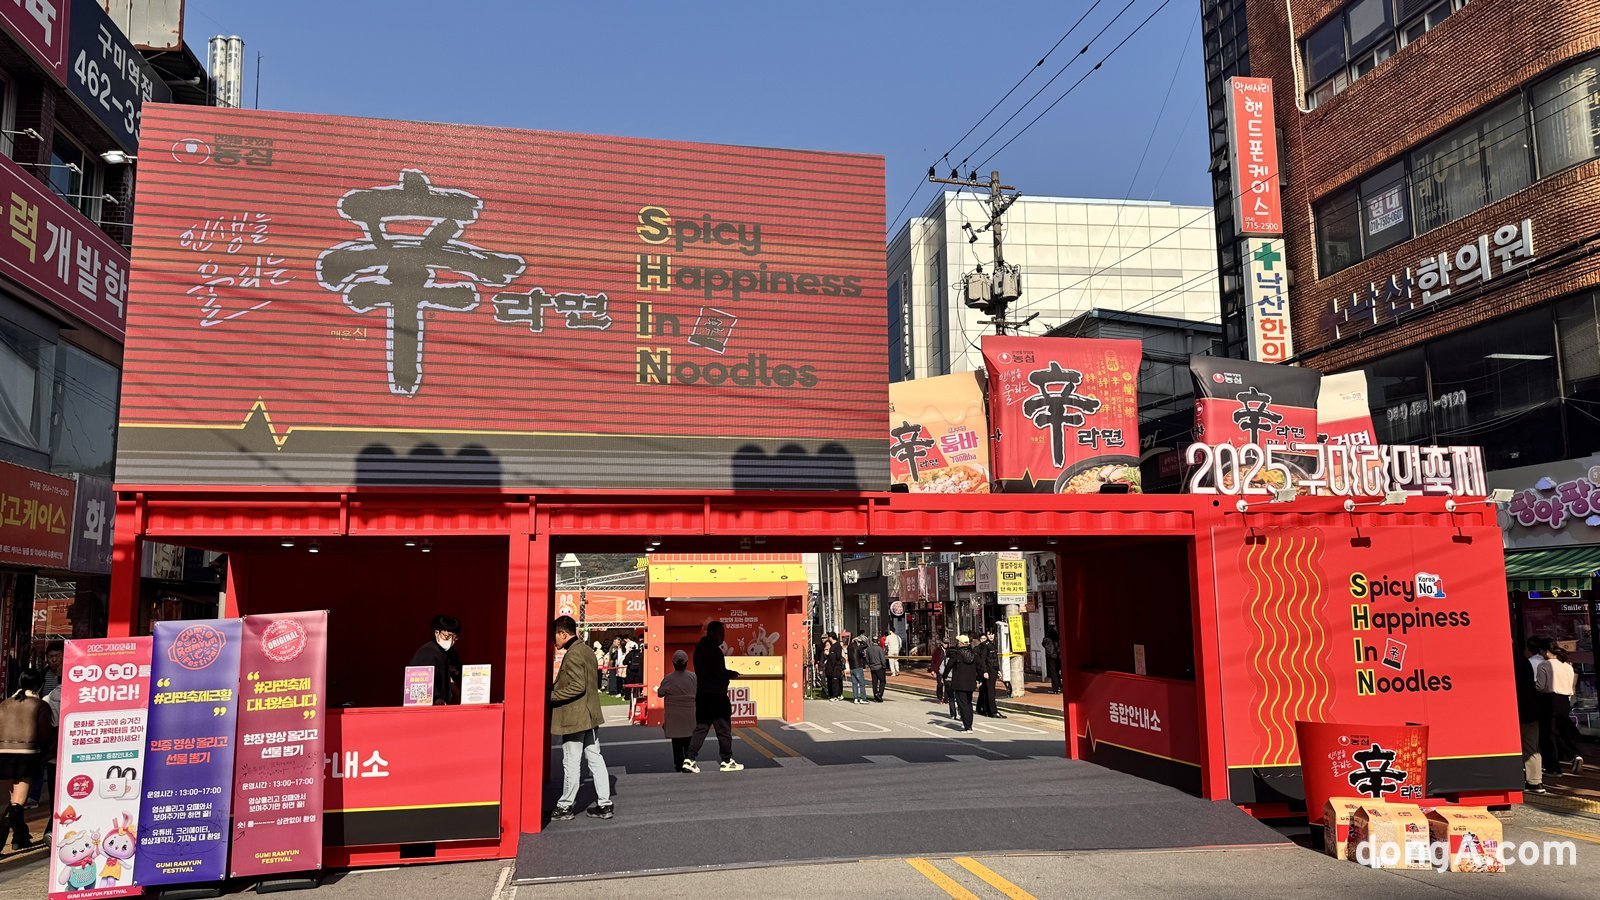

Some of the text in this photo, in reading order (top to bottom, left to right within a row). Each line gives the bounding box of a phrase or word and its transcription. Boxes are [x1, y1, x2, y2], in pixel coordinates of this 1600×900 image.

[1234, 81, 1270, 93] 악세사리
[213, 145, 272, 166] 농심
[1244, 96, 1270, 215] 핸드폰케이스
[1369, 186, 1401, 219] 임대
[180, 212, 272, 254] 인생을
[637, 206, 762, 257] Spicy
[1245, 222, 1279, 231] 715-2500
[0, 191, 128, 318] 력개발학
[637, 254, 862, 301] Happiness
[1346, 219, 1537, 324] 낙산한의원
[186, 253, 297, 326] 울리는
[316, 168, 526, 398] 辛
[491, 287, 612, 333] 라면
[637, 300, 681, 339] In
[637, 347, 819, 388] Noodles
[1013, 355, 1035, 363] 농심
[1023, 361, 1101, 468] 辛
[1232, 386, 1284, 447] 辛
[940, 430, 979, 454] 툼바
[1077, 427, 1125, 450] 라면
[1275, 426, 1305, 439] 라면
[890, 420, 935, 482] 辛
[920, 458, 939, 468] 라면
[1186, 443, 1486, 497] 2025 구미라면축제
[1350, 572, 1415, 603] Spicy
[1352, 604, 1471, 634] Happiness
[87, 644, 104, 653] 2025
[267, 630, 300, 650] ORIGINAL
[1353, 637, 1378, 664] In
[73, 668, 98, 679] 부기
[1356, 668, 1453, 696] Noodles
[78, 684, 140, 703] 찾아라!
[253, 677, 311, 694] #라면축제
[153, 689, 233, 705] #라면축제근황
[246, 693, 318, 712] 다녀왔습니다
[73, 717, 141, 728] 문화로 곳곳에 숨겨진
[1109, 701, 1162, 732] 종합안내소
[69, 725, 144, 737] 부기누디 캐릭터를 찾아
[72, 734, 140, 746] 경품으로 교환하세요!
[243, 729, 319, 746] 현장 영상 올리고
[150, 735, 229, 752] 인증 영상 올리고
[261, 744, 304, 759] 선물 뽑기
[166, 751, 211, 766] 선물 뽑기
[1348, 743, 1408, 798] 辛
[147, 786, 222, 799] 운영시간 13:00-17:00
[242, 778, 314, 791] 운영시간 13:00-17:00
[1400, 784, 1423, 799] 라면
[281, 801, 295, 810] 하면
[302, 814, 317, 823] 환영
[255, 848, 300, 859] GUMI RAMYUN
[261, 856, 293, 865] FESTIVAL
[155, 859, 202, 869] GUMI RAMYUN
[162, 866, 194, 874] FESTIVAL
